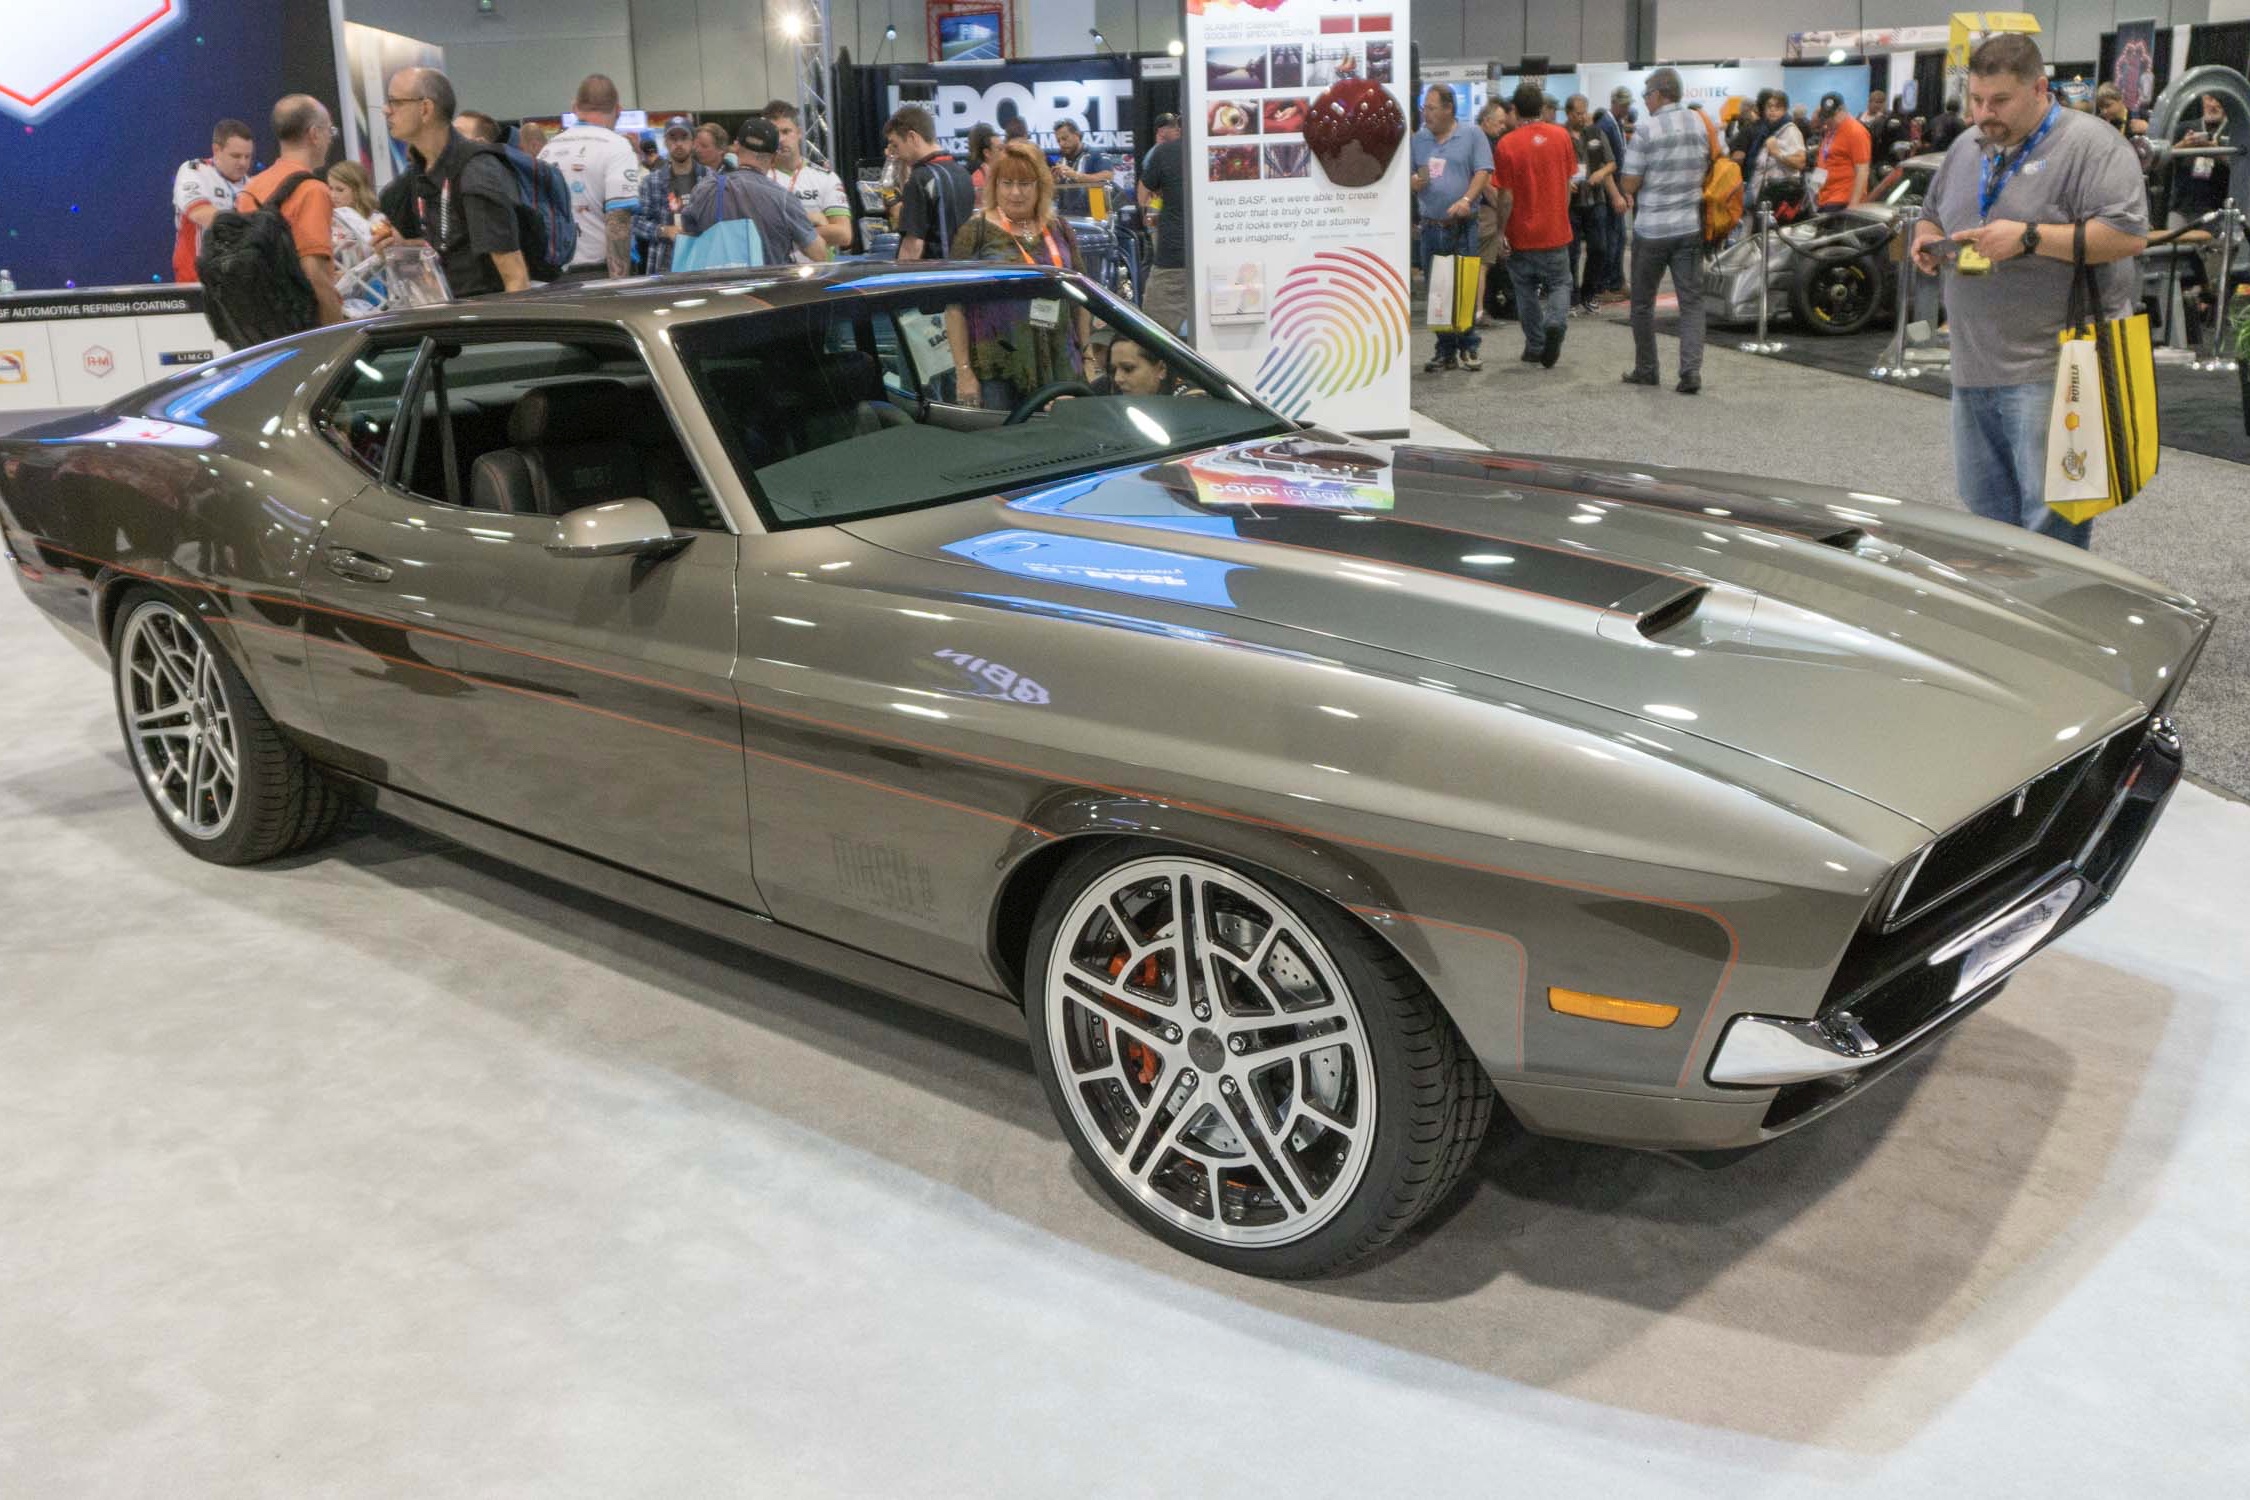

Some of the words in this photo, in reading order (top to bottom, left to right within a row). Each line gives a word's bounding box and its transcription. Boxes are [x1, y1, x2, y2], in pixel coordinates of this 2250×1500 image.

[1271, 196, 1285, 204] we
[1287, 195, 1310, 204] were
[1313, 192, 1333, 202] able
[1336, 192, 1346, 201] to
[1348, 191, 1378, 201] create
[1223, 209, 1247, 218] color
[1250, 208, 1268, 217] that
[1271, 207, 1279, 216] is
[1281, 206, 1301, 218] truly
[1304, 207, 1321, 216] our
[1213, 222, 1234, 232] And
[1236, 222, 1243, 231] it
[1245, 220, 1271, 230] looks
[1273, 219, 1298, 230] every
[1300, 218, 1313, 228] bit
[1316, 219, 1327, 227] as
[1329, 216, 1370, 227] stunning
[1214, 236, 1226, 245] as
[1228, 235, 1243, 244] we
[12, 305, 81, 317] AUTOMOTIVE
[82, 302, 131, 314] REFINISH
[132, 299, 186, 312] COATINGS
[176, 352, 211, 362] LIMCO
